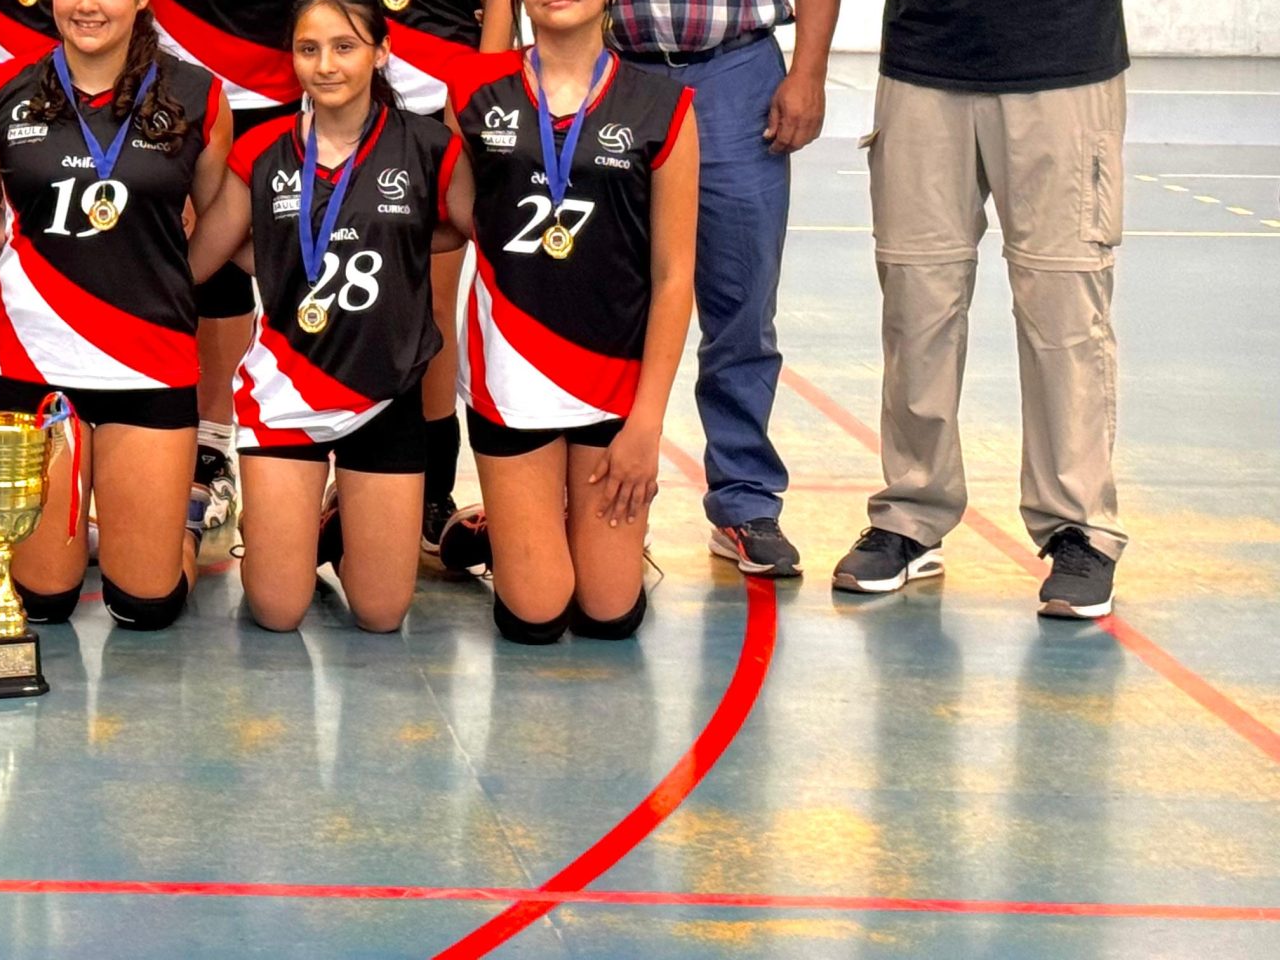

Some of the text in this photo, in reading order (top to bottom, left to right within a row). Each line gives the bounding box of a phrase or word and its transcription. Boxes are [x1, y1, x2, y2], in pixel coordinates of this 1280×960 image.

[8, 125, 48, 139] MAULE
[594, 155, 631, 170] CURICÓ
[43, 177, 129, 238] 19
[503, 194, 596, 254] 27
[298, 250, 383, 312] 28
